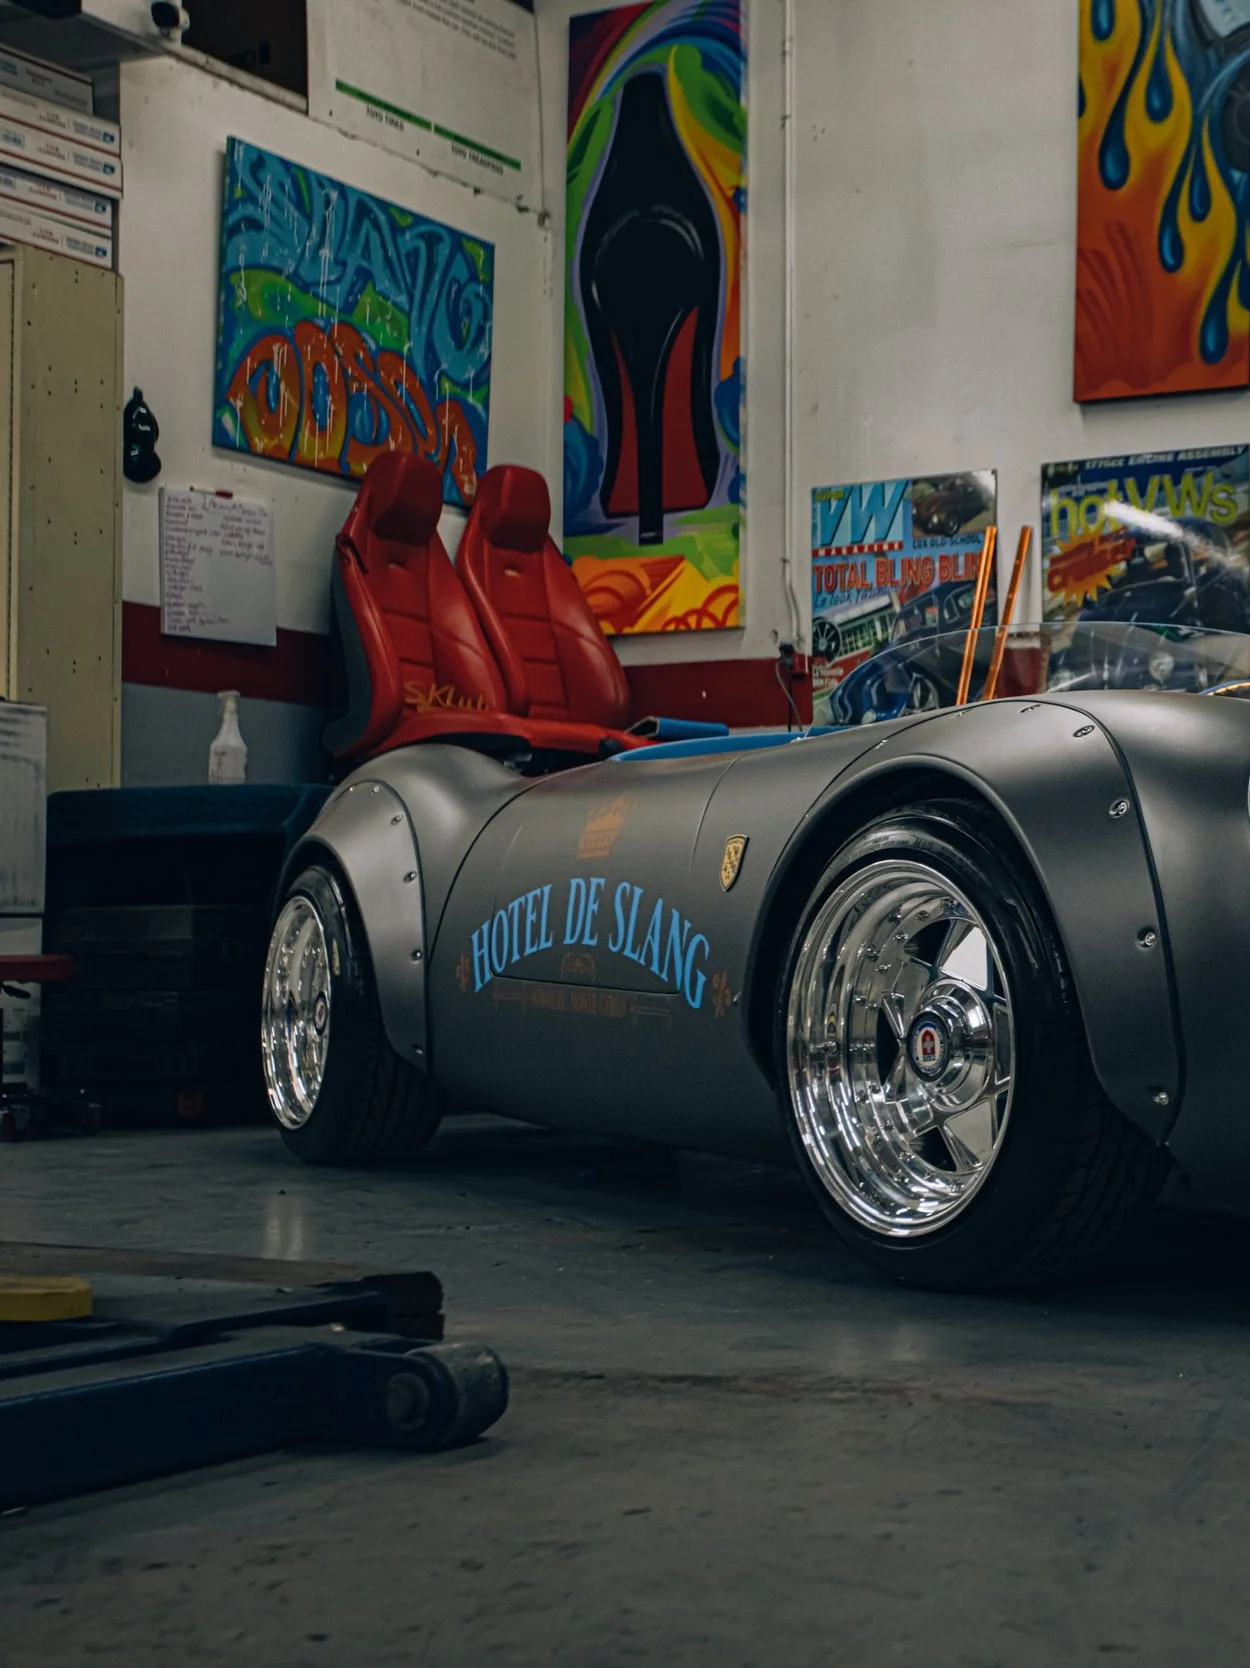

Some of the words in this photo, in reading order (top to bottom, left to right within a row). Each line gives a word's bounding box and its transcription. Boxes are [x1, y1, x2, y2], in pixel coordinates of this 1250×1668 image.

[1177, 445, 1246, 462] ASSEMBLY
[816, 479, 908, 547] VW
[813, 561, 871, 593] TOTAL
[875, 555, 935, 588] BLING
[938, 550, 984, 583] BLIN
[471, 883, 553, 993] HOTEL
[563, 877, 606, 946] DE
[608, 881, 710, 1009] SLANG
